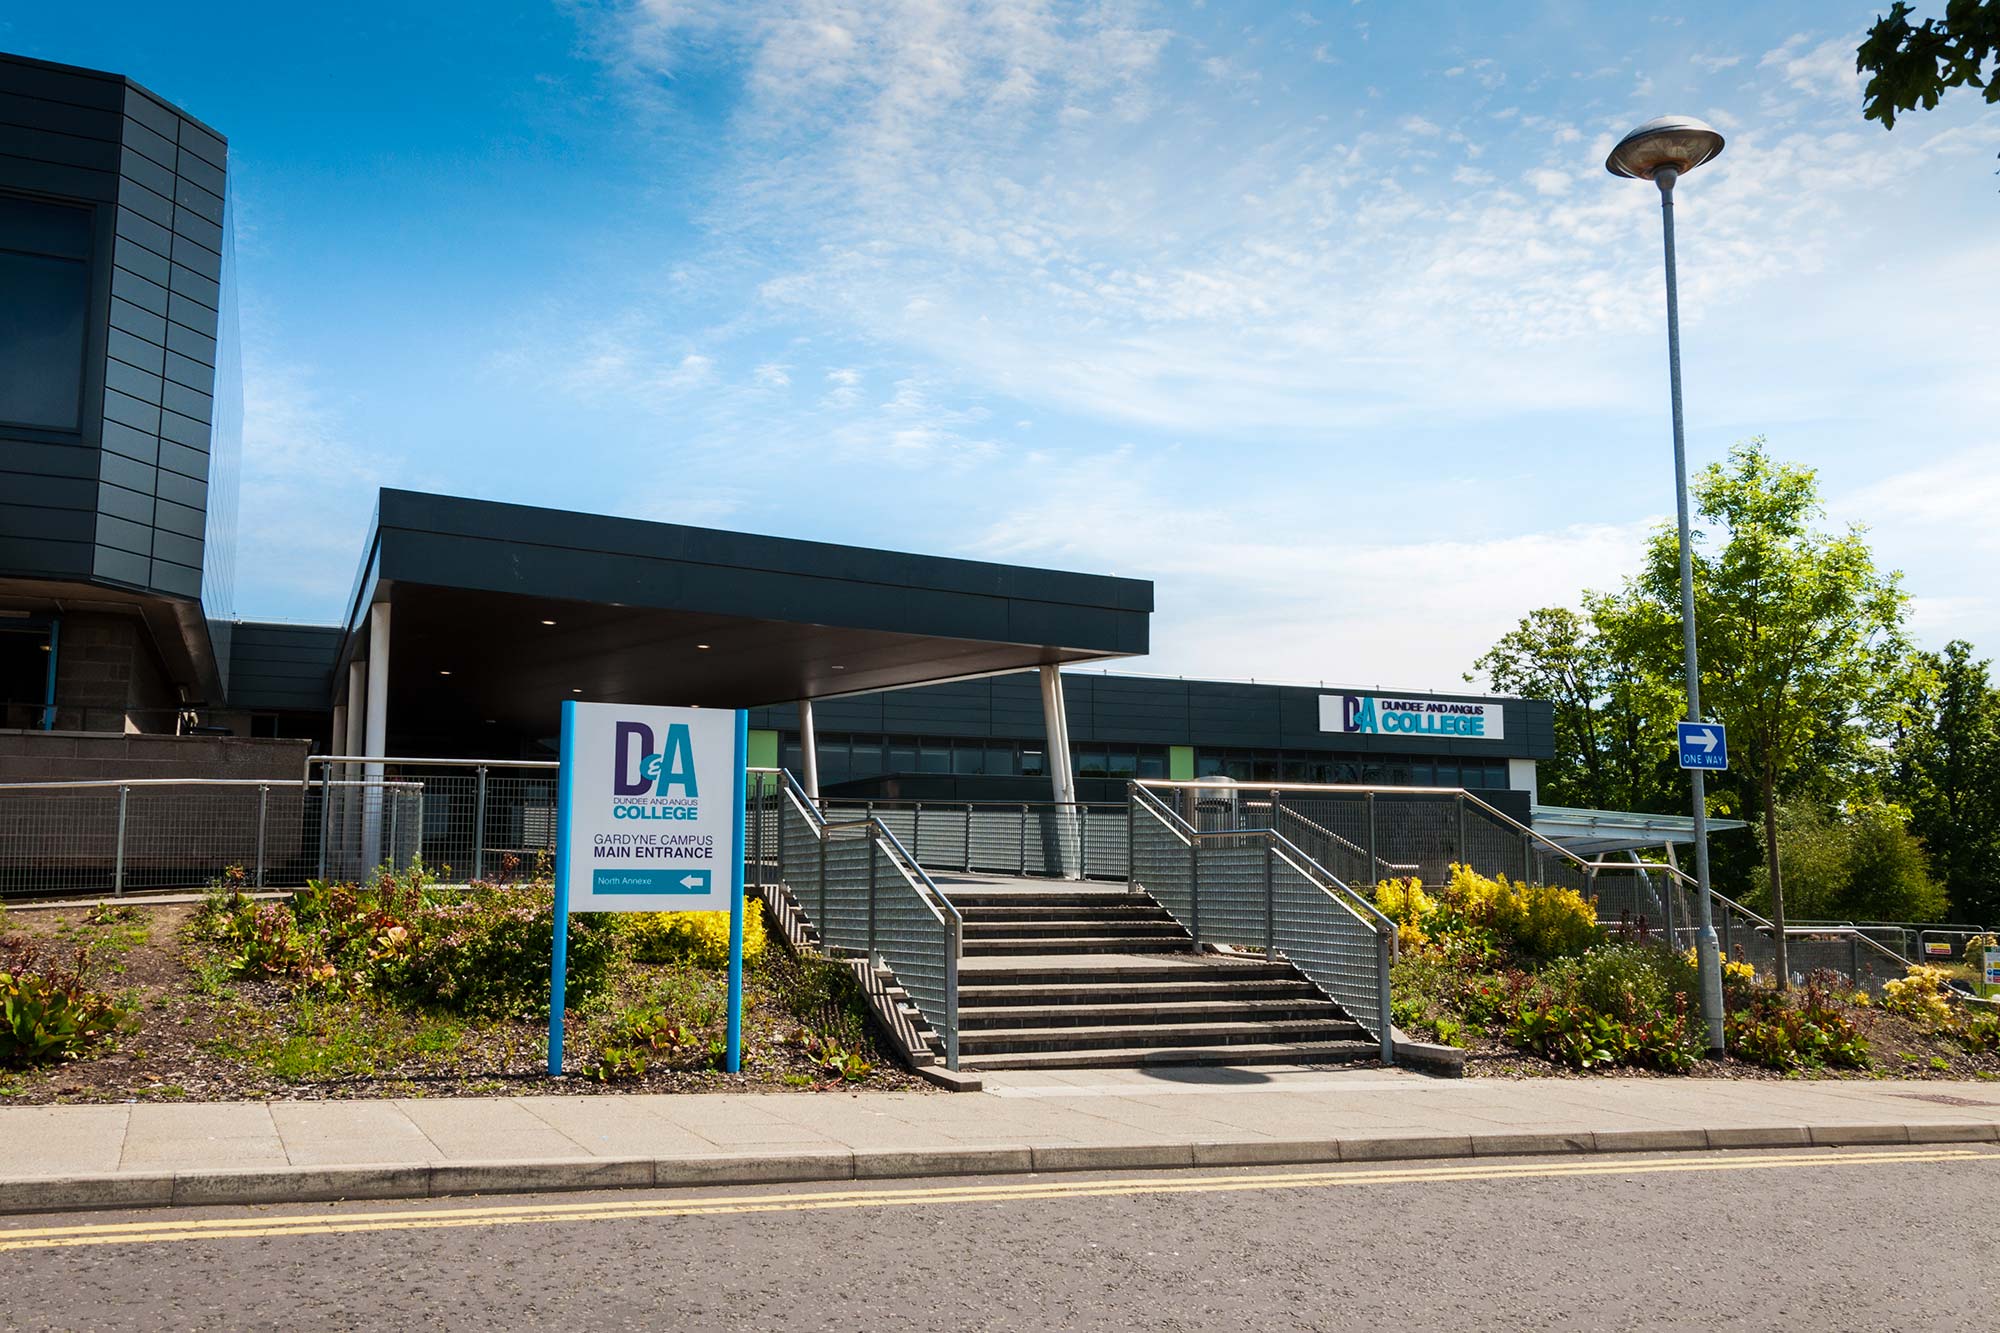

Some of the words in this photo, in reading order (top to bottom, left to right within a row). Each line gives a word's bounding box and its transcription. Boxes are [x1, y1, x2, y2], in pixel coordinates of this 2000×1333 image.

[1382, 700, 1424, 711] DUNDEE
[1426, 703, 1447, 713] AND
[1448, 704, 1484, 714] ANGUS
[1382, 712, 1484, 736] COLLEGE
[1684, 754, 1702, 764] ONE
[1705, 755, 1723, 765] WAY
[613, 797, 648, 805] DUNDEE
[613, 805, 698, 820] COLLEGE
[594, 834, 656, 845] GARDYNE
[660, 835, 713, 846] CAMPUS
[594, 846, 630, 858] MAIN
[635, 846, 713, 858] ENTRANCE
[598, 876, 620, 885] North
[622, 877, 652, 885] Annexe
